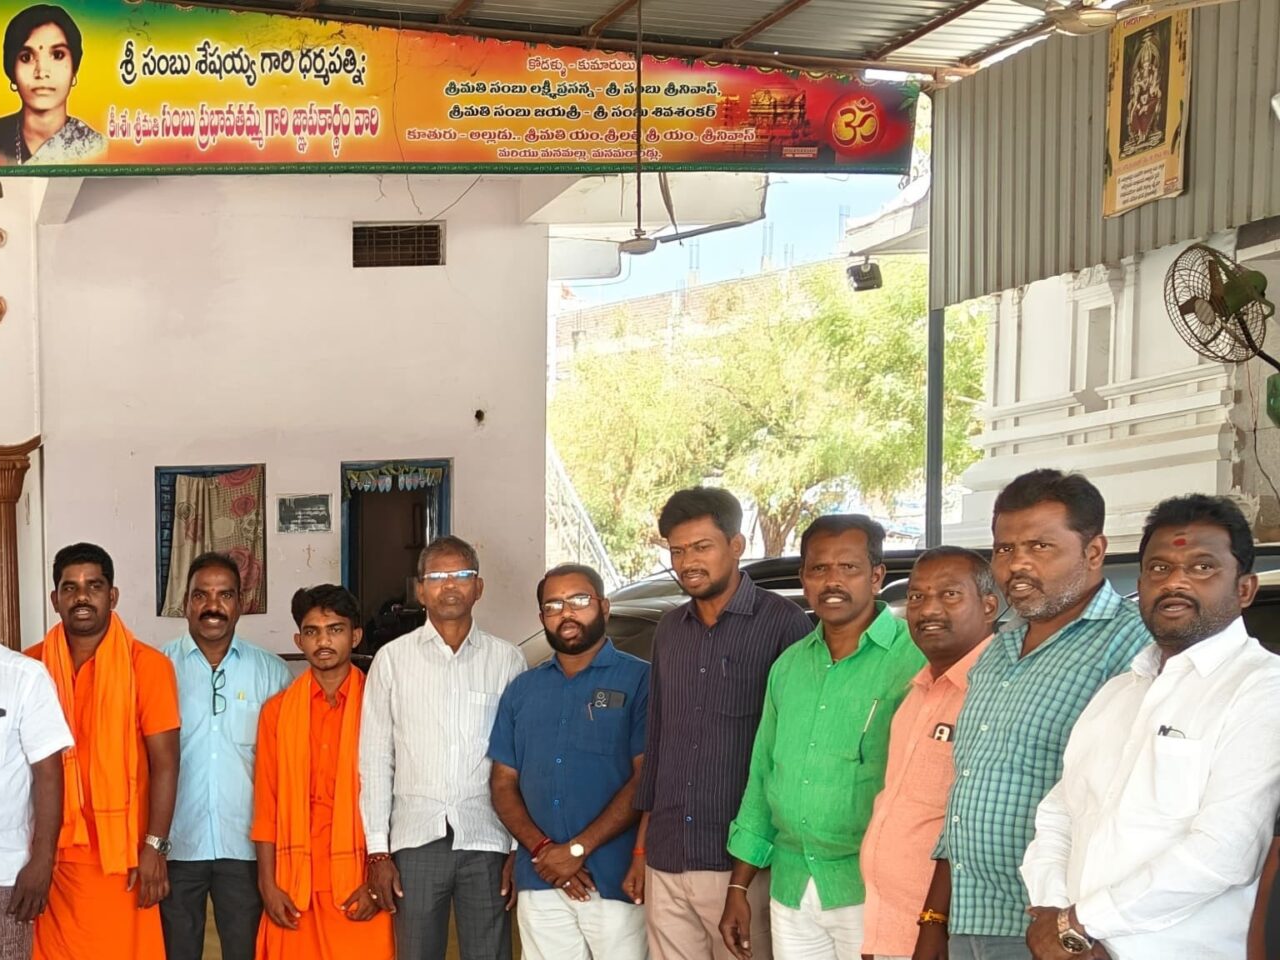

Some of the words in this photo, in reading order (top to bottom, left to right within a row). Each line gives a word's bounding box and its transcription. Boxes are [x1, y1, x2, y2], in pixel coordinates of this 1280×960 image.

[120, 41, 137, 84] శ్రీ
[142, 48, 190, 75] సంబు
[196, 41, 257, 86] శేషయ్య
[261, 50, 294, 73] గారి
[578, 60, 635, 71] కుమారులు
[445, 81, 486, 95] శ్రీమతి
[490, 83, 527, 94] సంబు
[606, 82, 620, 96] శ్రీ
[449, 104, 490, 119] శ్రీమతి
[494, 106, 530, 117] సంబు
[593, 105, 608, 119] శ్రీ
[134, 111, 159, 144] శ్రీమతి
[162, 104, 195, 137] సంబు
[198, 104, 263, 149] ప్రభావతమ్మ
[265, 108, 289, 136] గారి
[354, 108, 379, 136] వారి
[525, 128, 566, 142] శ్రీమతి
[646, 128, 660, 142] శ్రీ
